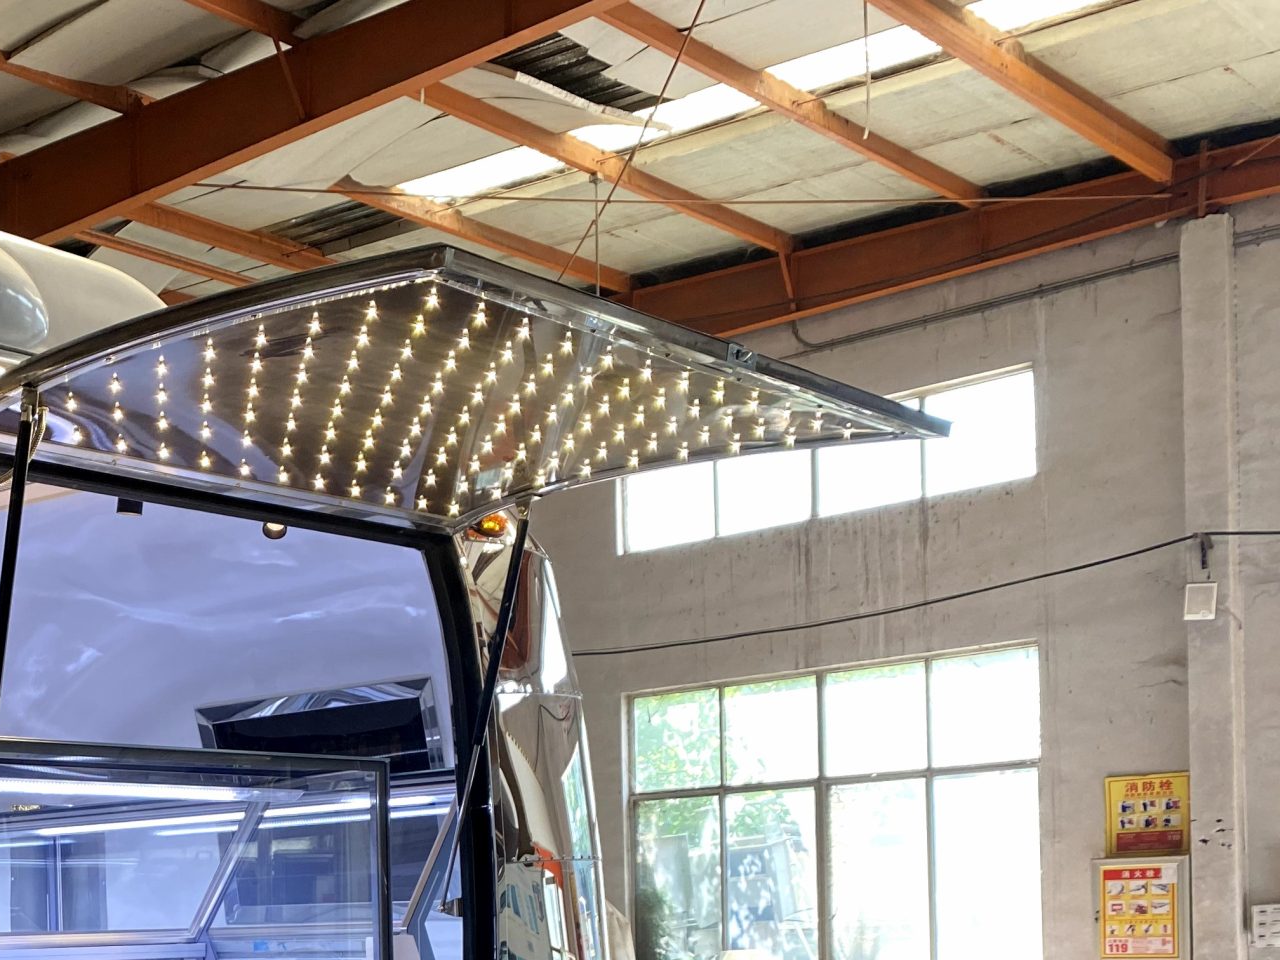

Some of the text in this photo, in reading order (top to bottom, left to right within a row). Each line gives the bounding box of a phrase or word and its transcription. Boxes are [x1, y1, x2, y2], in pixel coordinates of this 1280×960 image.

[1124, 780, 1173, 793] 消防栓
[1121, 869, 1161, 879] 消火栓
[1108, 943, 1128, 953] 119
